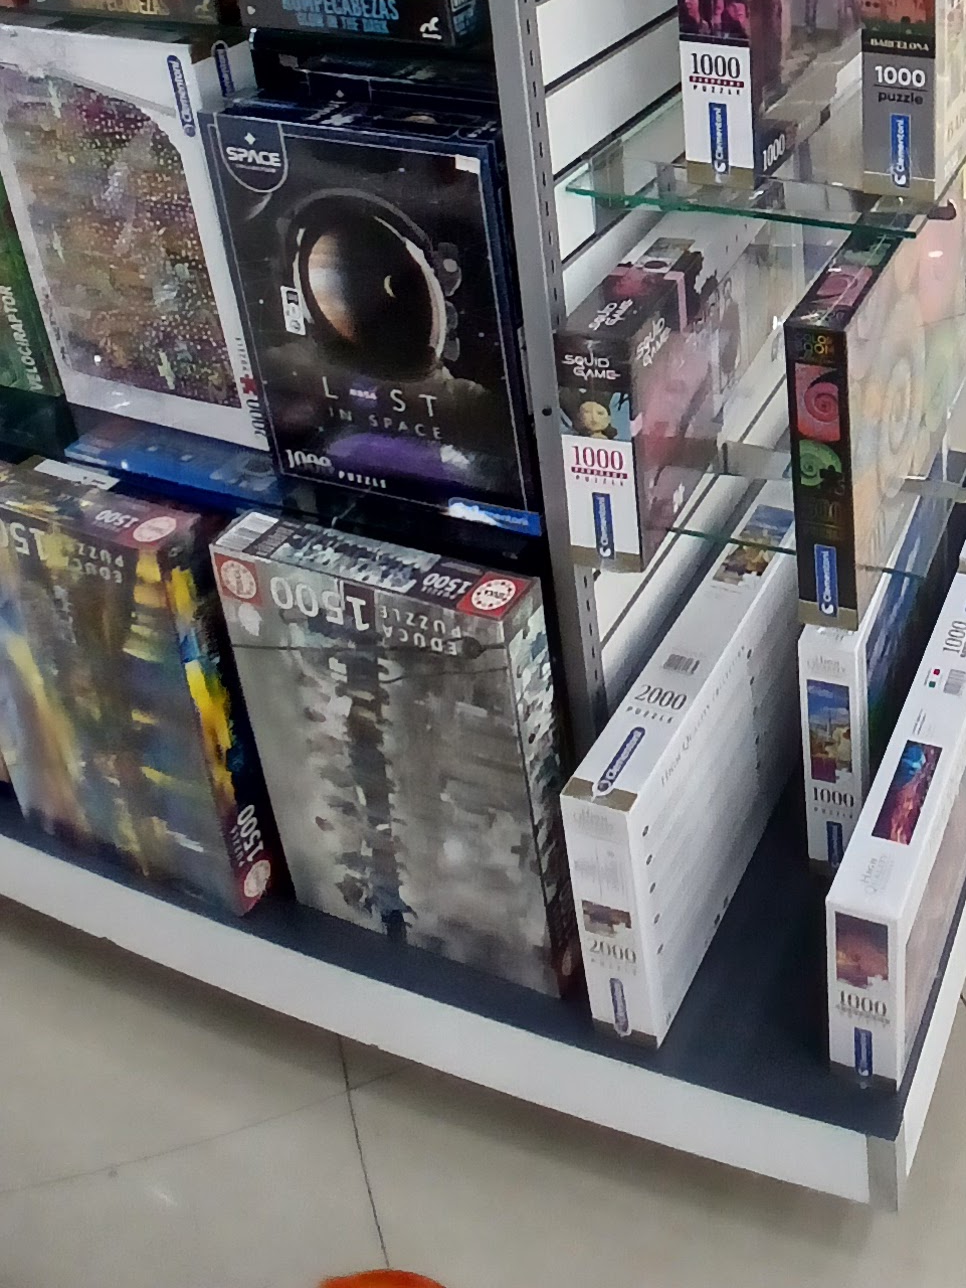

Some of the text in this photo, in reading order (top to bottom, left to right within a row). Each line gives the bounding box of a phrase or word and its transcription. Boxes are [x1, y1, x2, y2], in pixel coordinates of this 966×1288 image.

[870, 38, 930, 52] BARCELONA
[691, 52, 741, 79] 1000
[874, 65, 926, 88] 1000
[877, 90, 924, 106] puzzle
[225, 145, 282, 167] SPACE
[762, 133, 787, 172] 1000
[561, 348, 610, 369] SQUID
[572, 365, 622, 381] GAME
[328, 406, 443, 441] IN SPACE
[571, 445, 624, 471] 1000
[338, 470, 387, 489] PUZZLE
[95, 508, 140, 529] 1500
[422, 572, 473, 595] 1500
[269, 575, 371, 632] 1500
[378, 603, 463, 640] PUZZLE
[382, 624, 459, 656] EDUCA
[634, 683, 688, 711] 2000
[813, 786, 855, 808] 1000
[236, 804, 264, 862] 1500
[589, 938, 637, 964] 2000
[838, 990, 888, 1018] 1000
